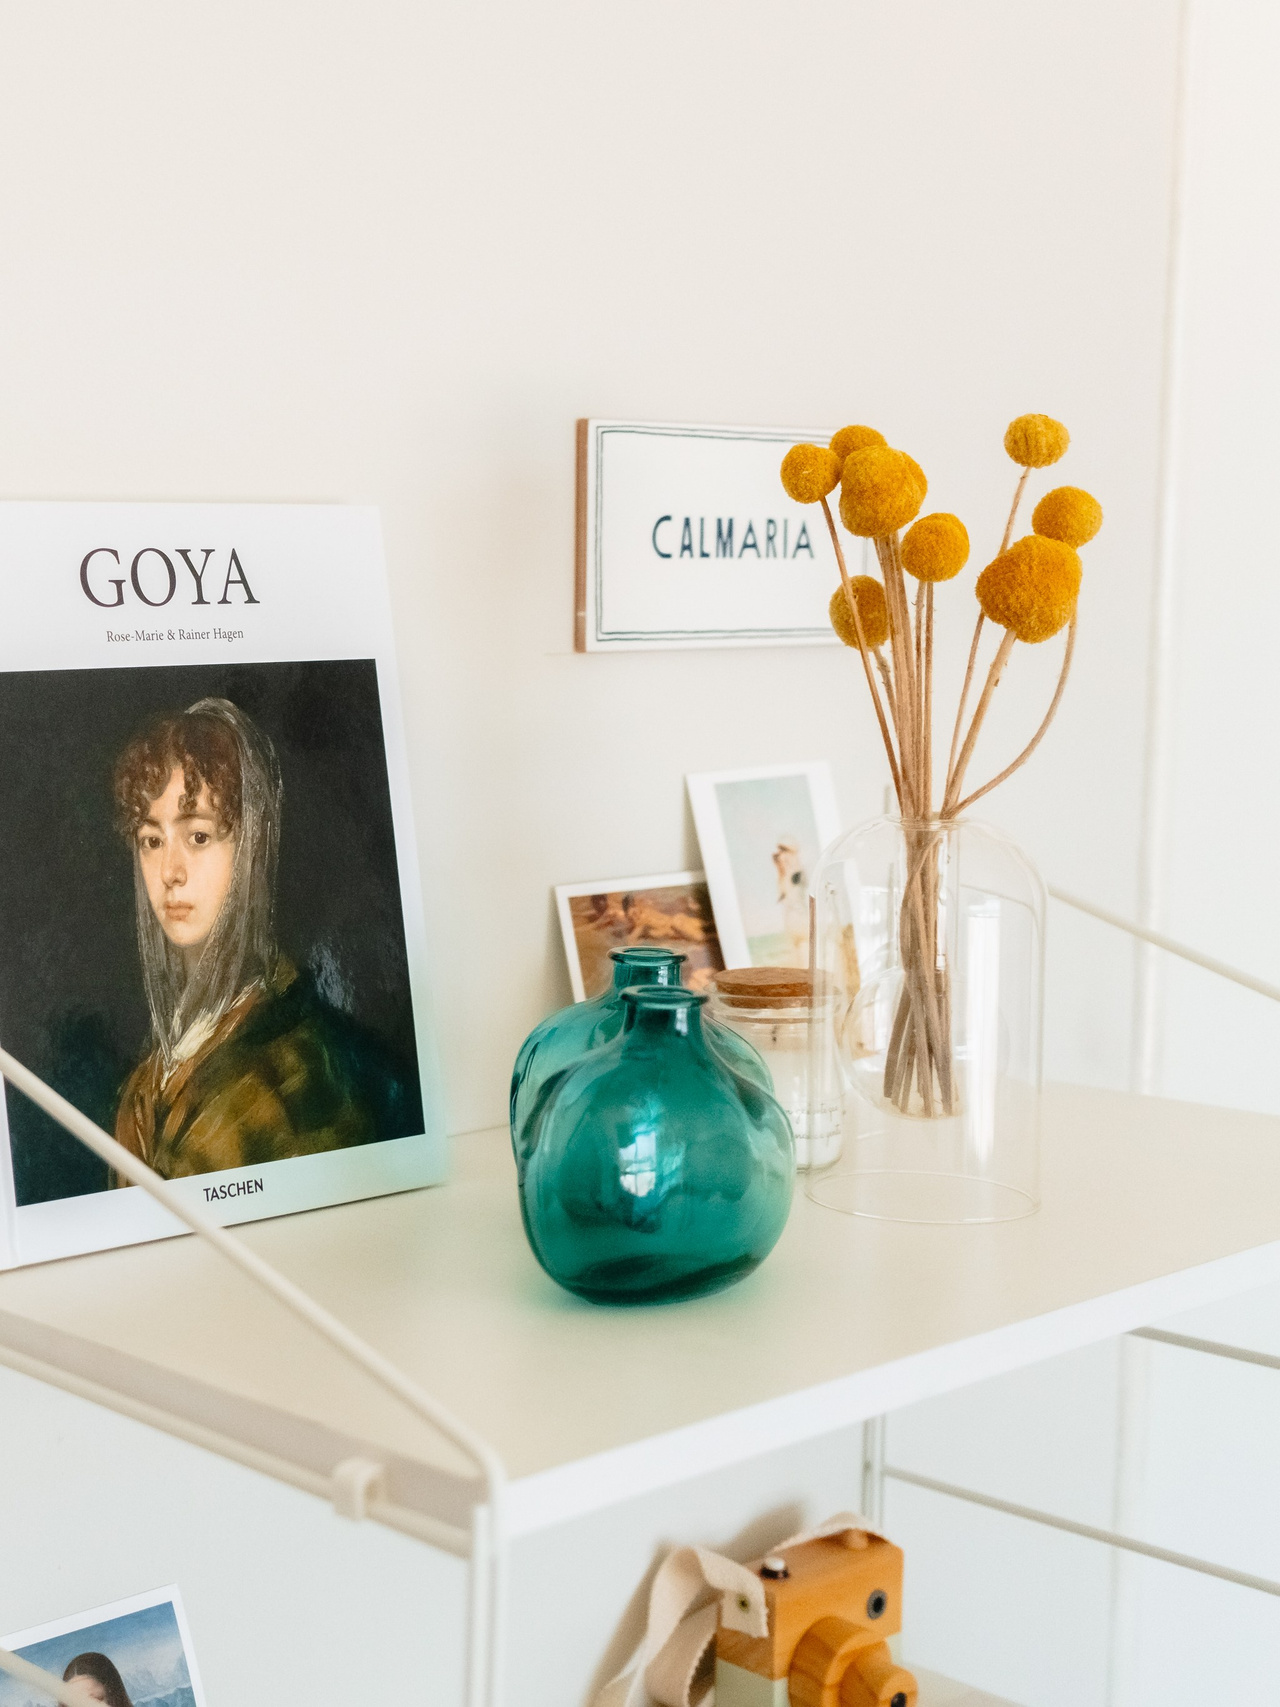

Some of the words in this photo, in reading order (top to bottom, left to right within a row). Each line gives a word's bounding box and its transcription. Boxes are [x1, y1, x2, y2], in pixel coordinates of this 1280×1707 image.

[651, 514, 815, 559] CALMARIA
[78, 547, 261, 608] GOYA
[106, 629, 164, 643] Rose-Marie
[167, 628, 176, 641] &
[178, 627, 211, 641] Rainer
[213, 627, 244, 643] Hagen
[202, 1177, 264, 1203] TASCHEN
